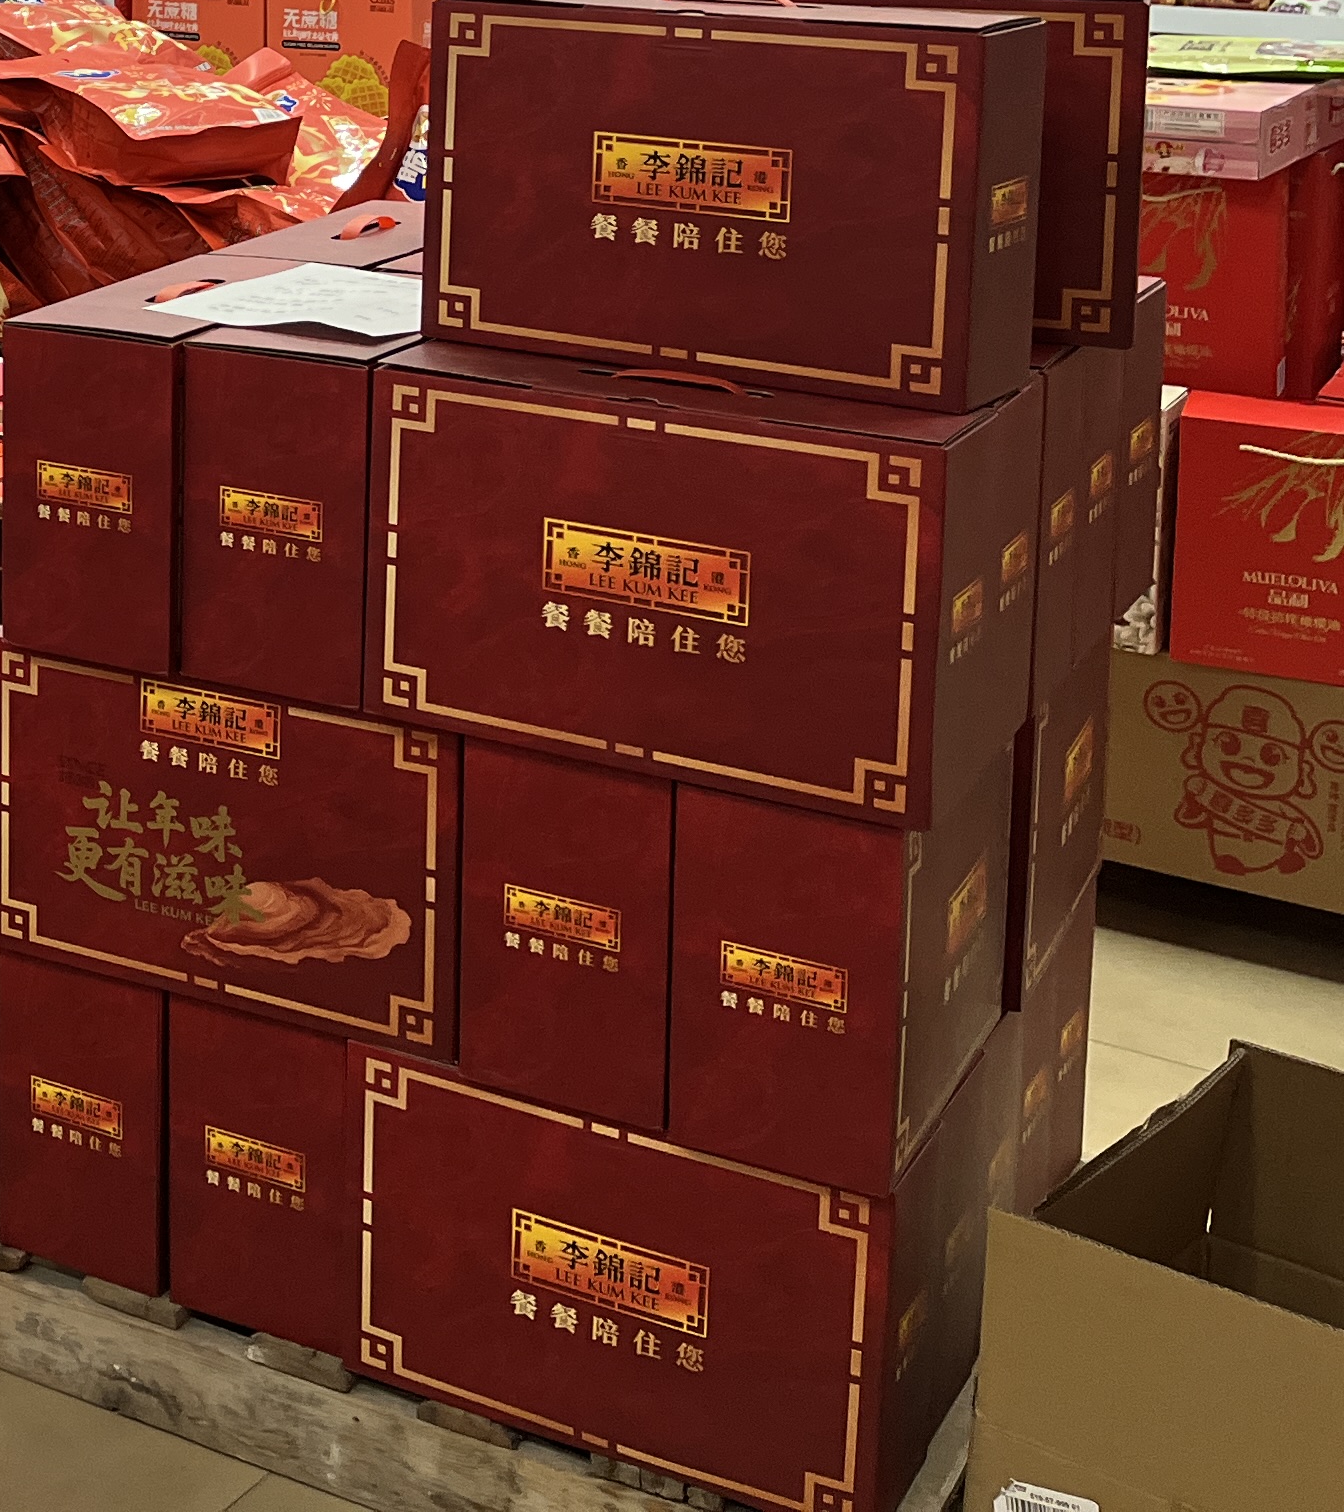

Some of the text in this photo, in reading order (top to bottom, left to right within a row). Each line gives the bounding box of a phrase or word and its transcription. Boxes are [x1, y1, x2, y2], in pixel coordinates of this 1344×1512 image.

[147, 0, 198, 21] 无蔗糖
[283, 7, 339, 30] 无蔗糖
[639, 149, 745, 190] 李錦記
[635, 180, 742, 207] LEE KUM KEE
[590, 212, 789, 260] 餐餐陪住您
[37, 503, 133, 535] 餐餐陪住您
[219, 530, 322, 564] 餐餐陪住您
[590, 541, 701, 589] 李錦記
[588, 572, 699, 606] LEE KUM KEE
[1242, 569, 1339, 596] MUELOLIVA
[540, 602, 747, 664] 餐餐陪住您
[171, 718, 247, 744] LEE KUM KEE
[172, 695, 248, 733] 李錦記
[138, 738, 280, 787] 餐餐陪住您
[82, 779, 244, 864] 让年味
[53, 824, 267, 927] 更有滋味
[133, 898, 217, 926] LEE KUM KE
[503, 931, 621, 972] 餐餐陪住您
[720, 990, 846, 1035] 餐餐陪住您
[557, 1239, 662, 1296] 李錦記
[553, 1265, 661, 1312] LEE KUM KEE
[510, 1288, 706, 1374] 餐餐陪住您
